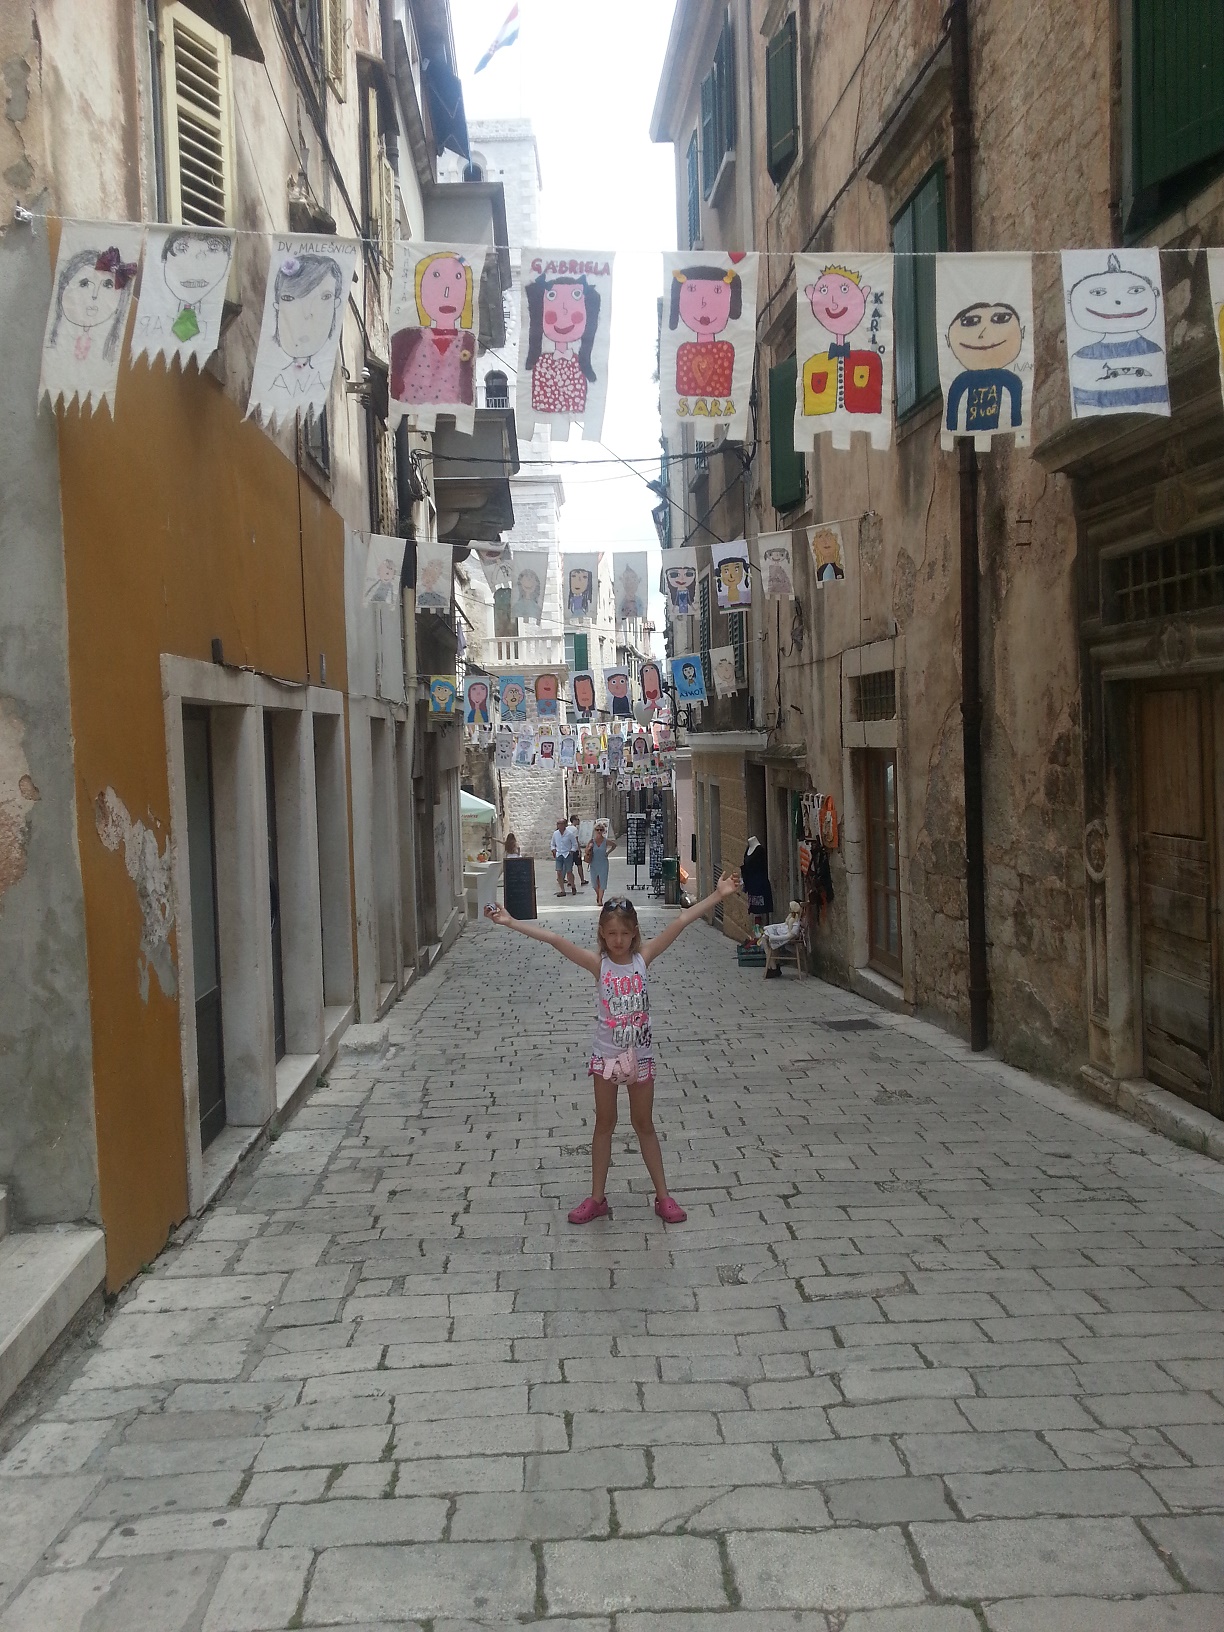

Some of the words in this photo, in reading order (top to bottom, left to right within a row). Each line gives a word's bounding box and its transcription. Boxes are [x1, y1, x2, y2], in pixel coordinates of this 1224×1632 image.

[530, 257, 611, 276] GABRIELA
[870, 291, 886, 354] KARLO
[268, 370, 326, 398] ANA
[676, 397, 736, 417] SARA
[611, 973, 643, 997] TOO
